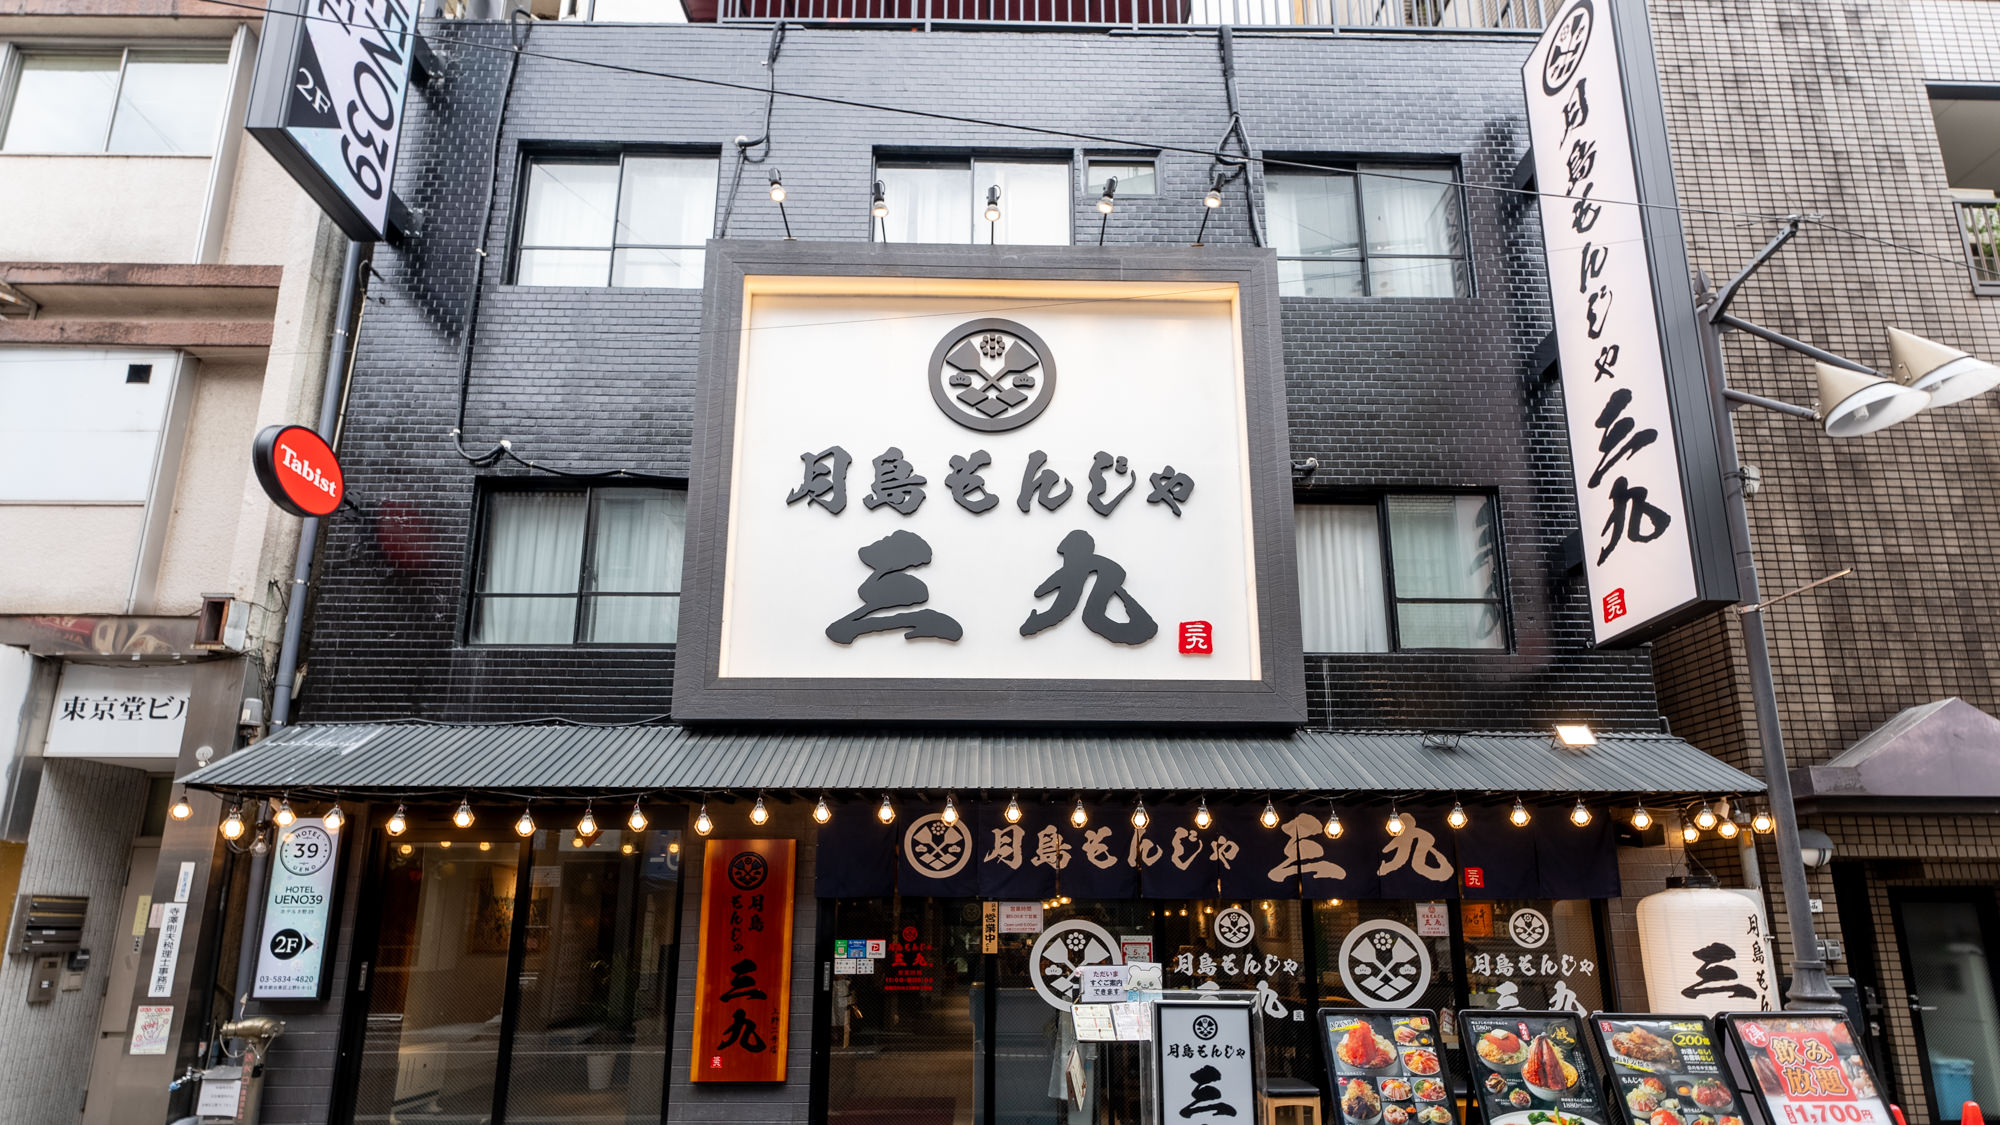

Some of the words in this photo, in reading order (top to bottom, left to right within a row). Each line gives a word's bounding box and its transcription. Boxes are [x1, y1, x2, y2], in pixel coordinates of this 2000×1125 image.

[296, 67, 331, 114] 2F
[341, 0, 410, 200] ENO39
[280, 444, 337, 497] Tabist
[786, 446, 1195, 517] 月島もんじゃ
[1587, 388, 1671, 567] 三九
[825, 529, 1159, 646] 三九
[1184, 624, 1208, 649] 三九
[296, 830, 321, 839] HOTEL
[983, 824, 1240, 870] 月島もんじゃ
[1268, 813, 1454, 882] 三九
[293, 843, 319, 858] 39
[293, 864, 316, 872] UENO
[274, 895, 323, 905] UENO39
[286, 886, 315, 894] HOTEL
[984, 913, 996, 943] 営業中
[274, 936, 299, 953] 2F
[1174, 952, 1298, 976] 月島もんじゃ
[1472, 953, 1595, 976] 月島もんじゃ
[1090, 979, 1123, 987] すぐご案内
[717, 958, 768, 1053] 三九
[1167, 1044, 1246, 1059] 月島もんじゃ
[1771, 1037, 1833, 1065] 飲み
[1783, 1066, 1848, 1095] 放題
